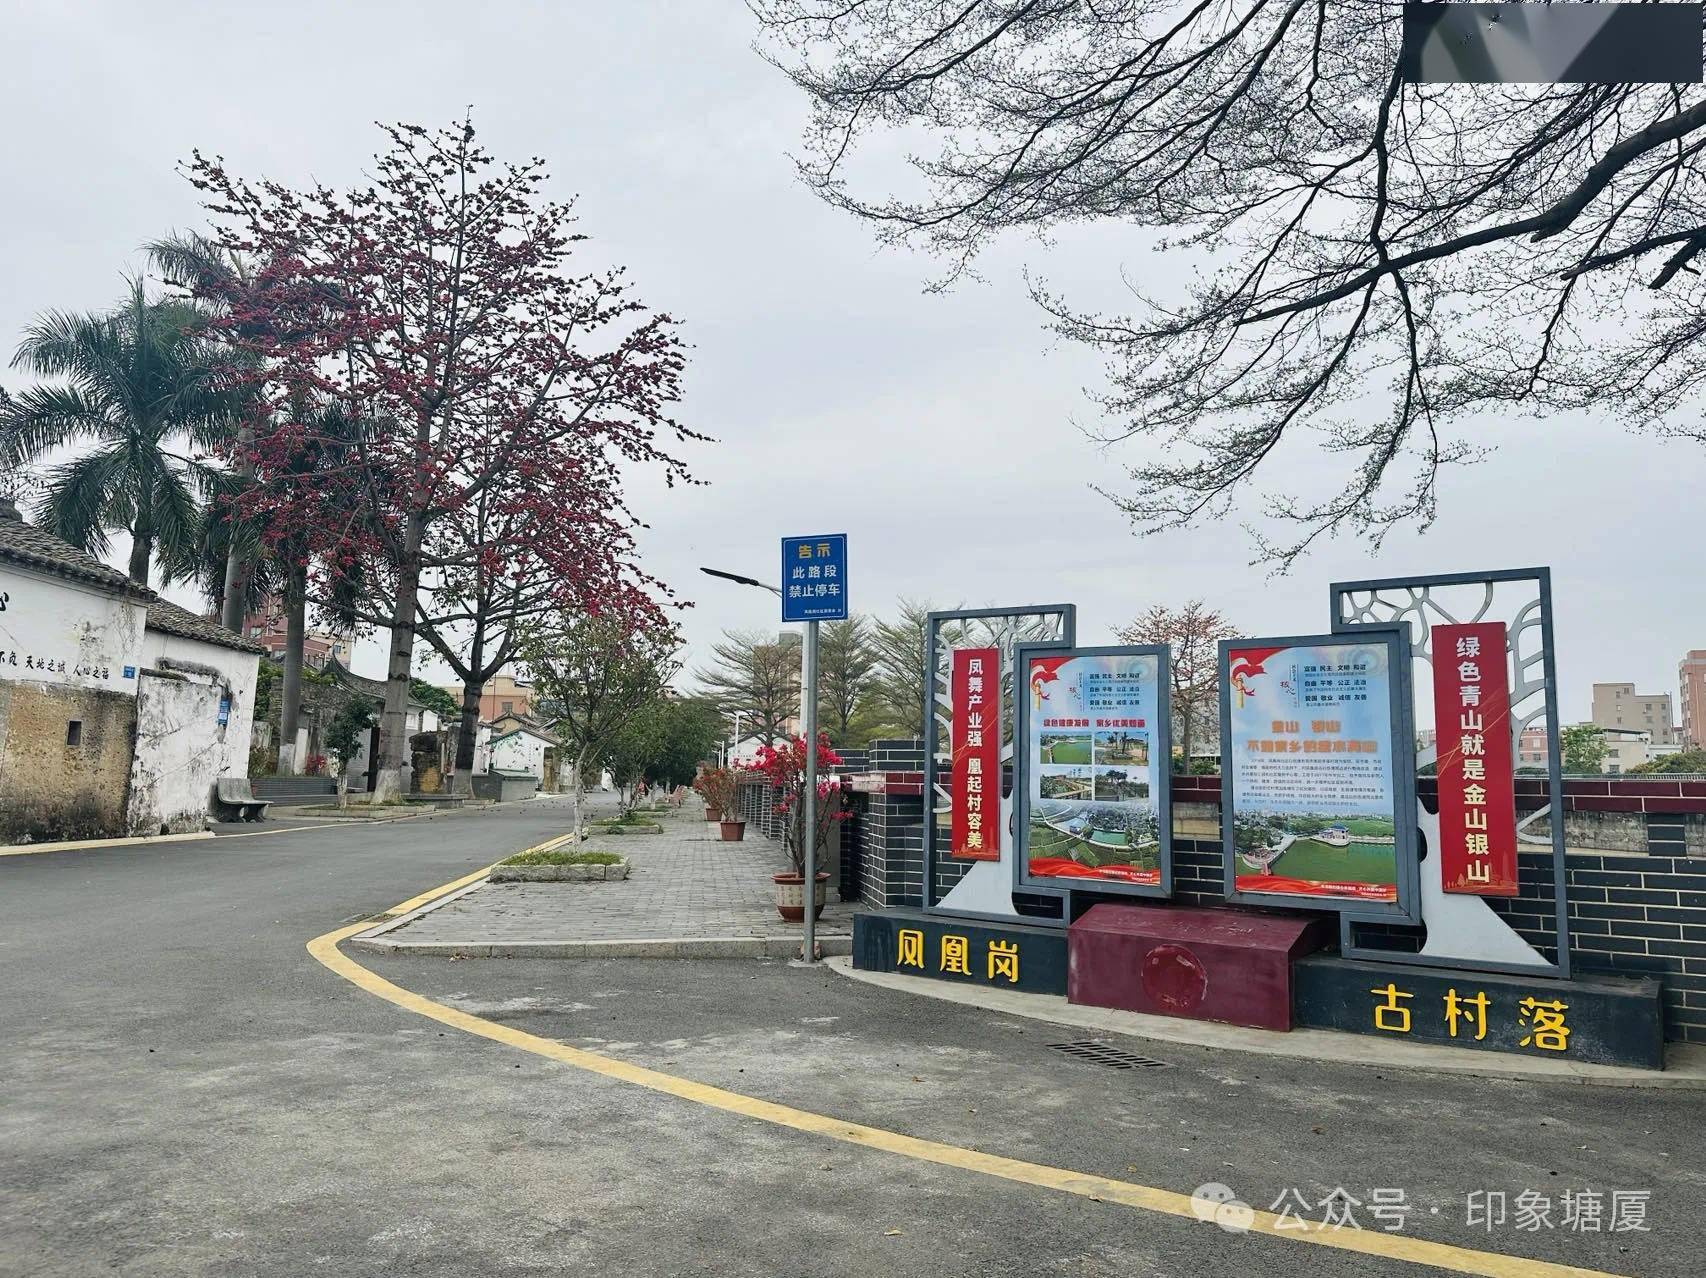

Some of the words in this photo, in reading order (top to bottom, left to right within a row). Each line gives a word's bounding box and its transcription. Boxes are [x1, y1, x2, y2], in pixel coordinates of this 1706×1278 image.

[792, 564, 837, 579] 此路段
[798, 543, 831, 559] 告示
[788, 583, 841, 598] 禁止停车
[967, 658, 983, 747] 凤舞产业强
[1455, 636, 1490, 884] 绿色青山就是金山银山
[967, 757, 983, 849] 凰起村容美
[896, 928, 1020, 983] 凤凰岗
[1370, 983, 1571, 1051] 古村落
